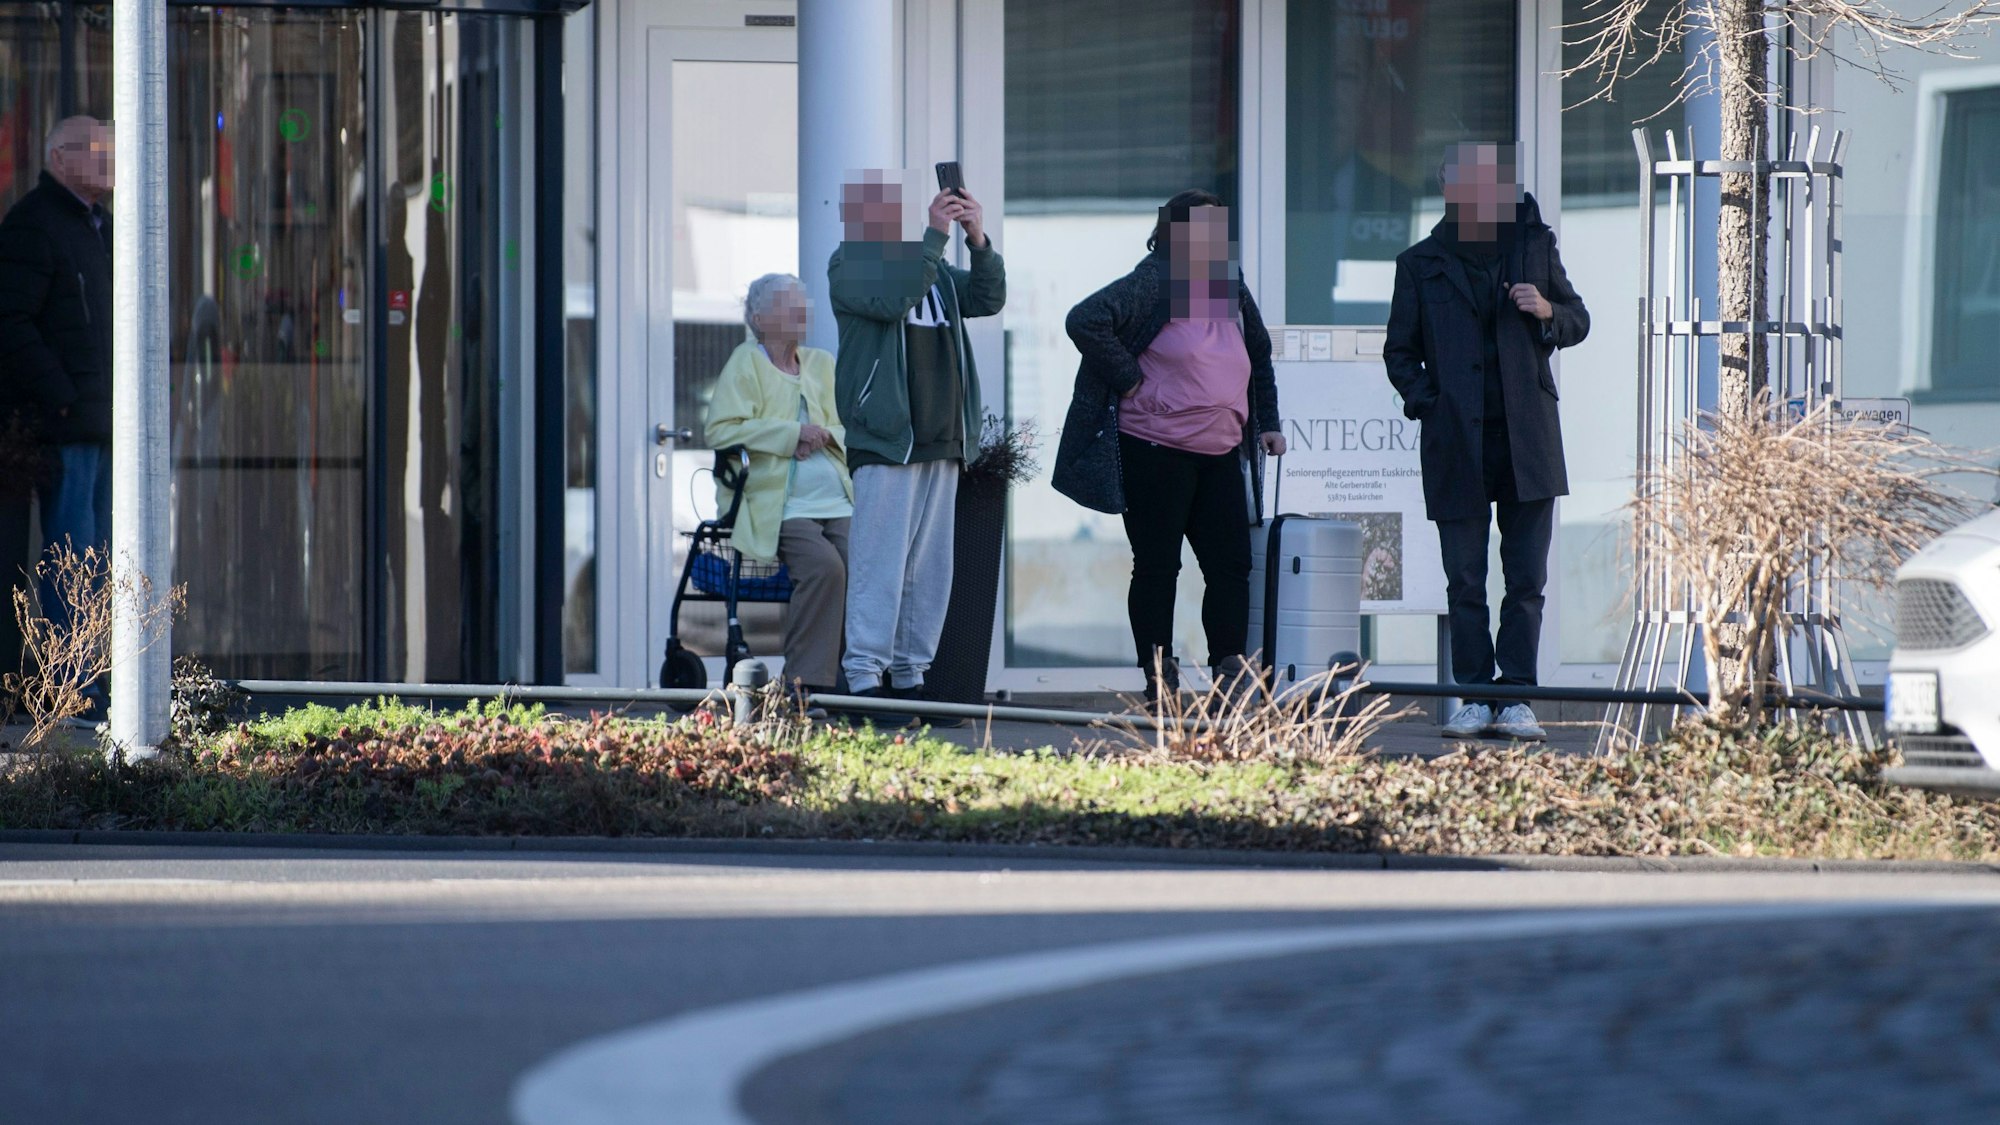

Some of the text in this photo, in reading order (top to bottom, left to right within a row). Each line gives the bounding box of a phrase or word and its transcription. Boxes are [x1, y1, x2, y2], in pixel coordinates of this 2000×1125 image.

[1286, 467, 1380, 479] Seniorenpflegezentrum
[1324, 481, 1338, 489] Alte
[1339, 481, 1382, 489] Gerberstraße
[1347, 493, 1383, 501] Euskirchen
